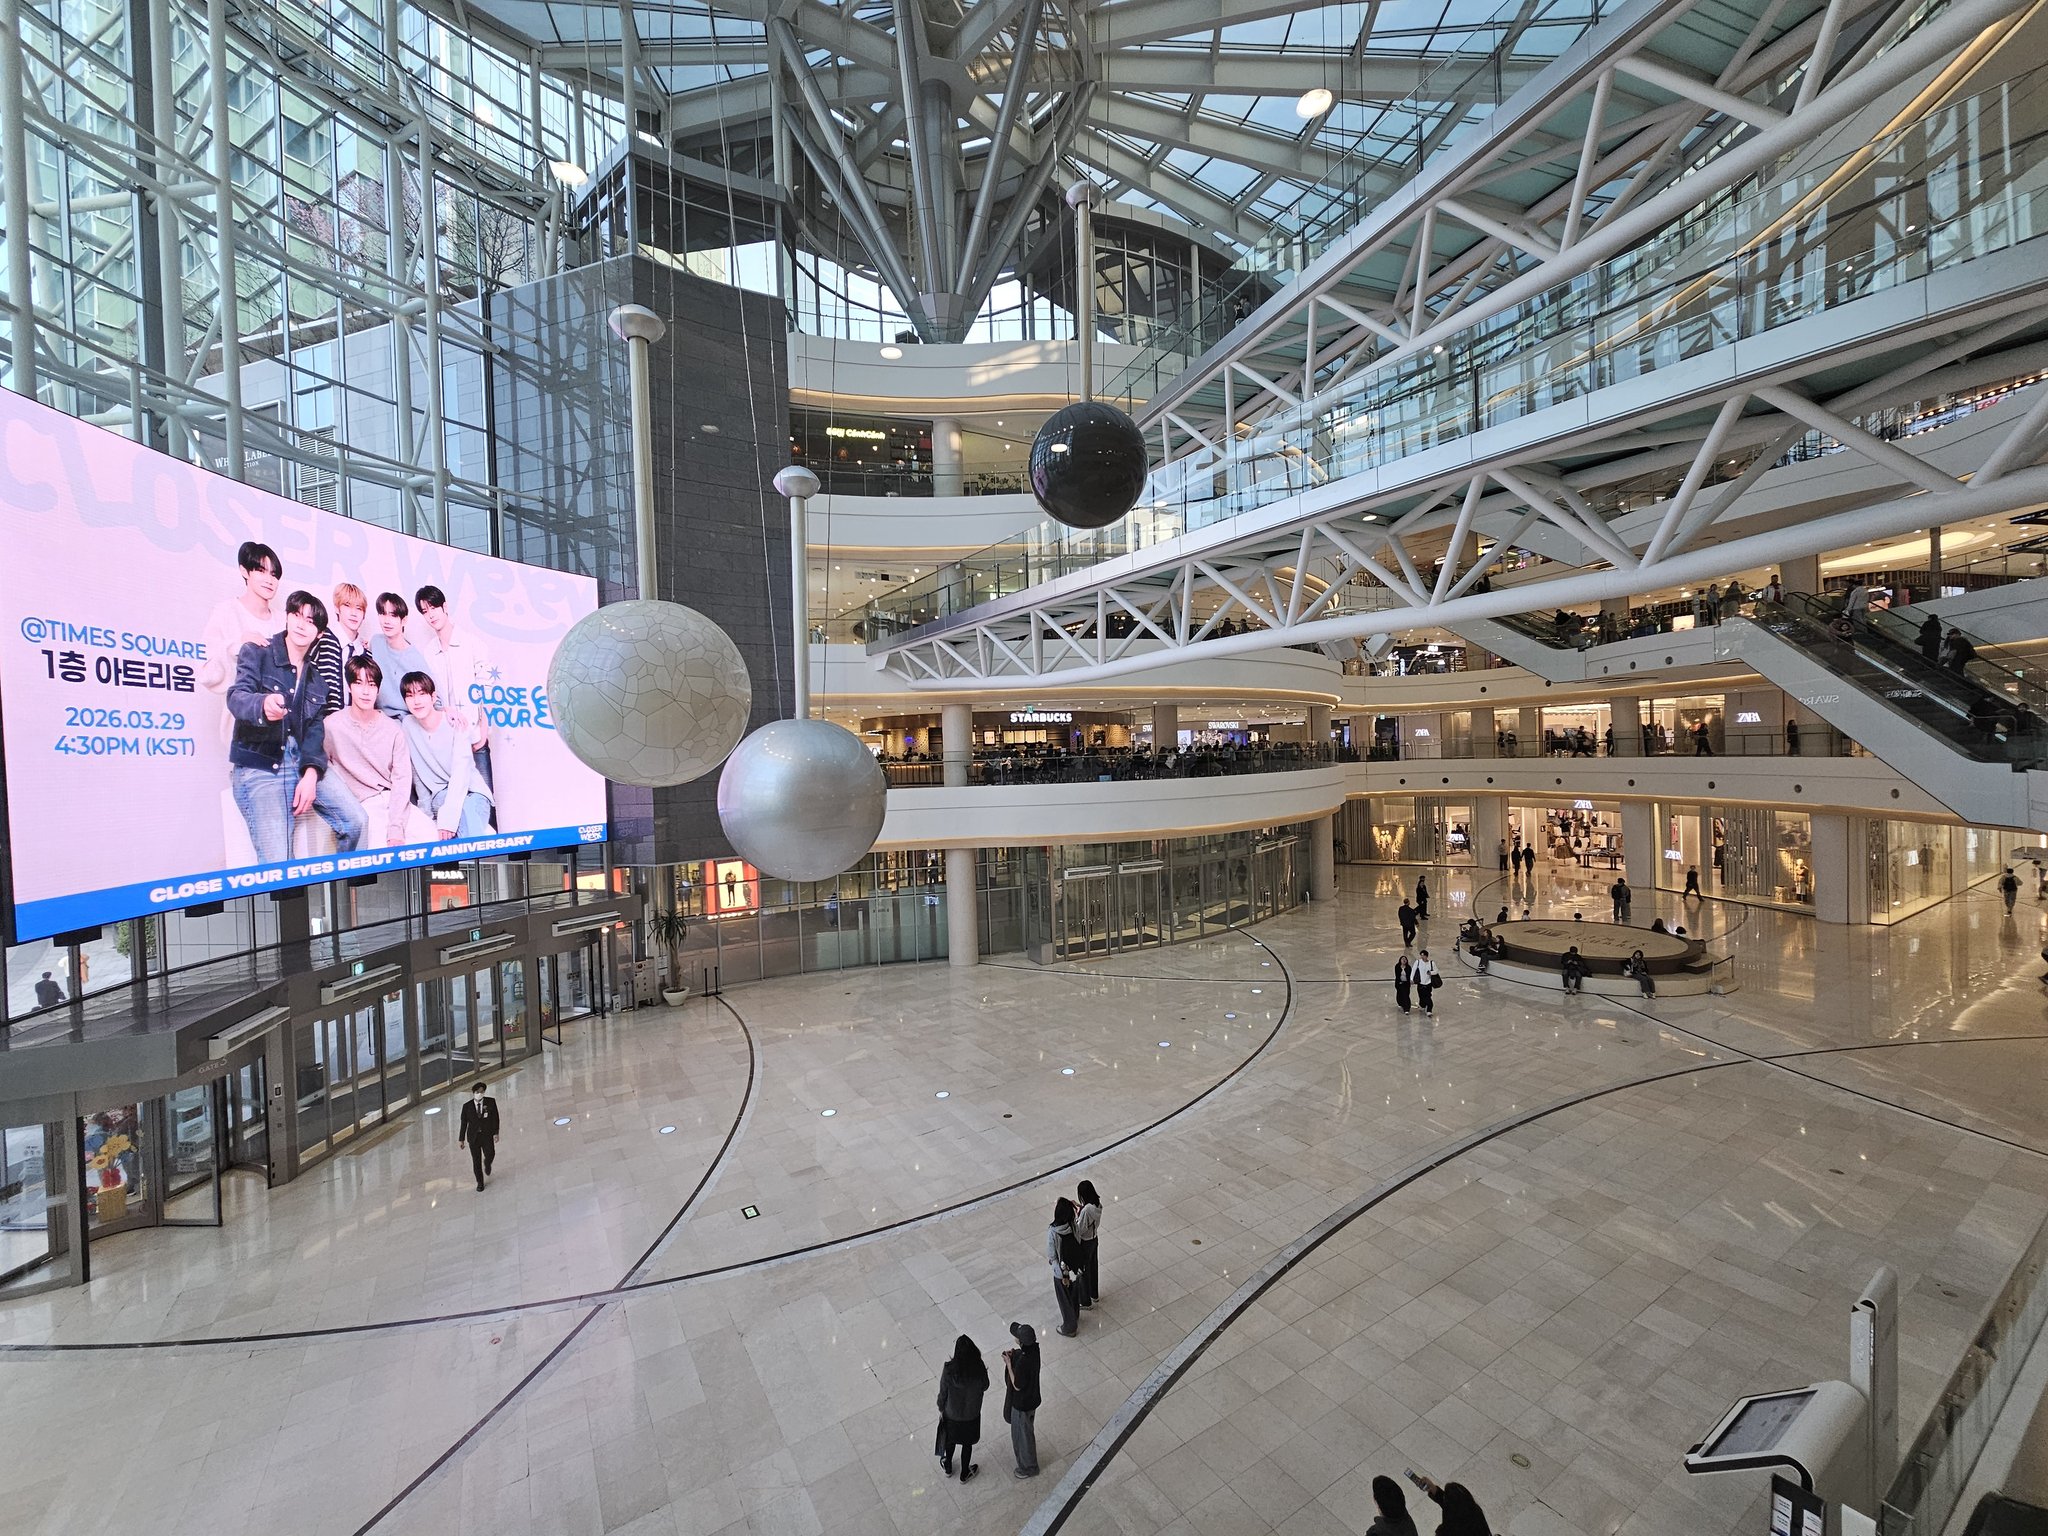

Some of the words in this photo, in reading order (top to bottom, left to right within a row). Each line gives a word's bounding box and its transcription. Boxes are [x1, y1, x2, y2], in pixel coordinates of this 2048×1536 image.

[245, 450, 273, 462] LABE
[21, 617, 117, 649] @TIMES
[121, 632, 208, 661] SQUARE
[41, 649, 87, 683] 1층
[95, 656, 196, 692] 아트리움
[468, 684, 527, 706] CLOSE
[65, 707, 185, 730] 2026.03.29
[483, 706, 532, 728] YOUR
[1010, 713, 1072, 722] STARBUCKS
[1208, 721, 1239, 729] SWAROVSKI
[1736, 712, 1761, 722] ZARA
[54, 735, 140, 755] 4:30PM
[146, 737, 195, 757] (KST)
[150, 878, 222, 903] CLOSE
[227, 868, 282, 888] YOUR
[287, 861, 334, 879] EYES
[338, 852, 395, 871] DEBUT
[398, 848, 428, 862] 1ST
[431, 835, 534, 858] ANNIVERSARY
[431, 870, 465, 880] PRADA
